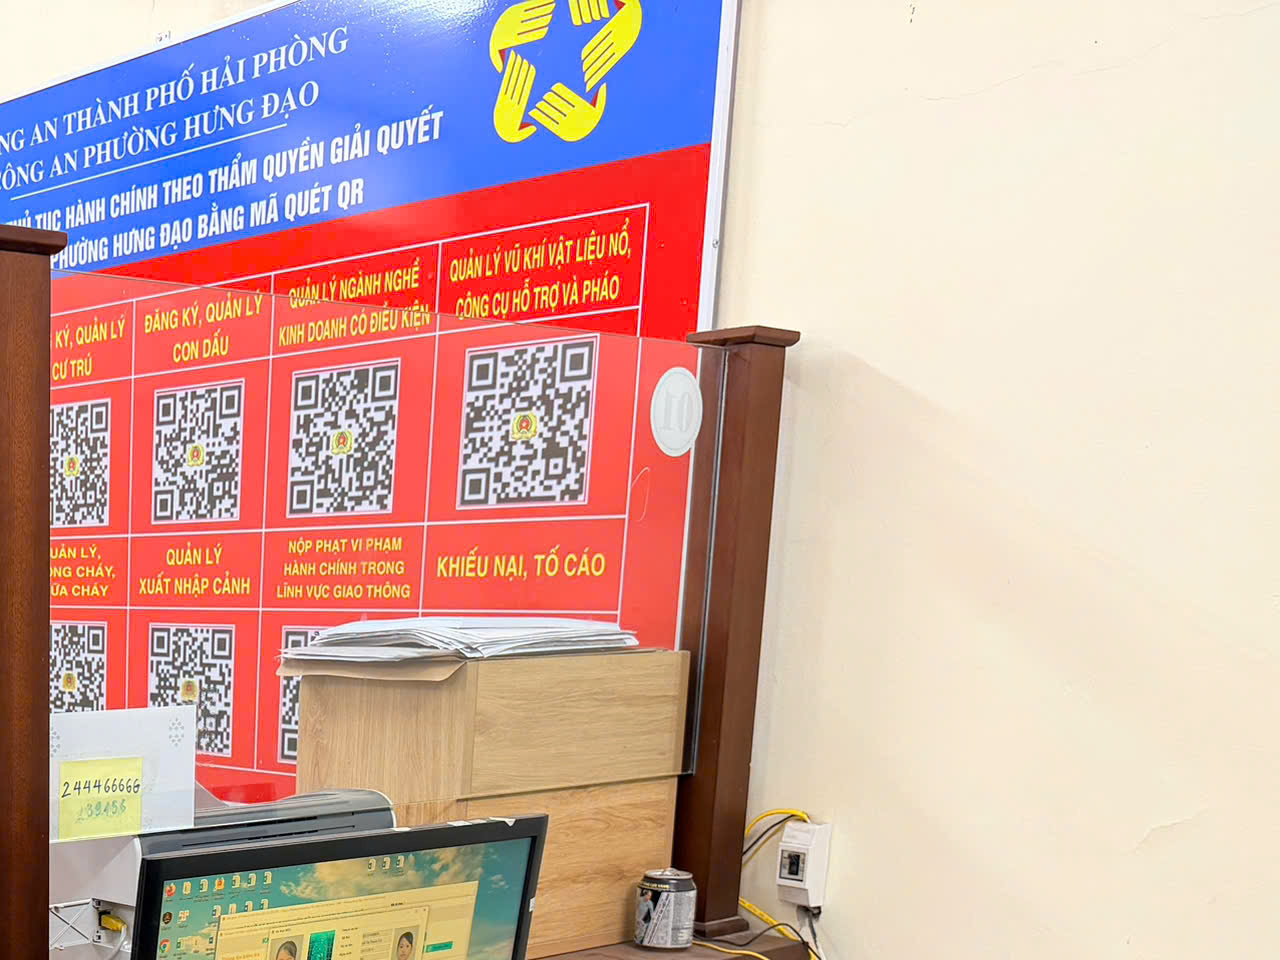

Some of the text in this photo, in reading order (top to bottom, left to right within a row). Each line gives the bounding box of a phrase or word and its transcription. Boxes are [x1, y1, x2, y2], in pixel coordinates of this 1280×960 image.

[30, 118, 58, 146] AN
[63, 97, 139, 136] THÀNH
[145, 63, 195, 112] PHỐ
[200, 55, 245, 95] HẢI
[252, 26, 349, 79] PHÒNG
[49, 150, 78, 178] AN
[83, 122, 177, 169] PHƯỜNG
[184, 99, 255, 141] HƯNG
[261, 80, 320, 120] ĐẠO
[65, 197, 106, 230] HÀNH
[110, 184, 158, 218] CHÍNH
[163, 172, 204, 206] THEO
[208, 152, 258, 194] THẨM
[263, 136, 324, 183] QUYỀN
[330, 123, 371, 165] GIẢI
[376, 104, 445, 156] QUYẾT
[50, 236, 108, 269] PHƯỜNG
[112, 224, 155, 257] HƯNG
[160, 217, 193, 250] ĐẠO
[197, 202, 245, 240] BẰNG
[249, 192, 279, 227] MÃ
[284, 182, 332, 222] QUÉT
[337, 178, 365, 211] QR
[450, 217, 632, 282] QUẢN LÝ VŨ KHÍ VẬT LIỆU NỔ,
[288, 257, 421, 310] QUẢN LÝ NGÀNH NGHỀ
[456, 269, 620, 322] CÔNG CỤ HỖ TRỢ VÀ PHÁO
[144, 292, 264, 334] ĐĂNG KÝ, QUẢN LÝ
[278, 299, 431, 348] KINH DOANH CÓ ĐIỀU KIỆN
[55, 315, 125, 350] KÝ, QUẢN LÝ
[173, 329, 230, 363] CON DẤU
[52, 354, 93, 381] CƯ TRÚ
[50, 544, 101, 560] UẢN LÝ,
[166, 541, 222, 566] QUẢN LÝ
[288, 537, 402, 556] NỘP PHẠT VI PHẠM
[436, 544, 606, 581] KHIẾU NẠI, TỐ CÁO
[76, 563, 116, 579] CHÁY,
[139, 570, 251, 598] XUẤT NHẬP CẢNH
[283, 558, 405, 576] HÀNH CHÍNH TRONG
[72, 582, 108, 597] CHÁY
[276, 581, 411, 600] LĨNH VỰC GIAO THÔNG
